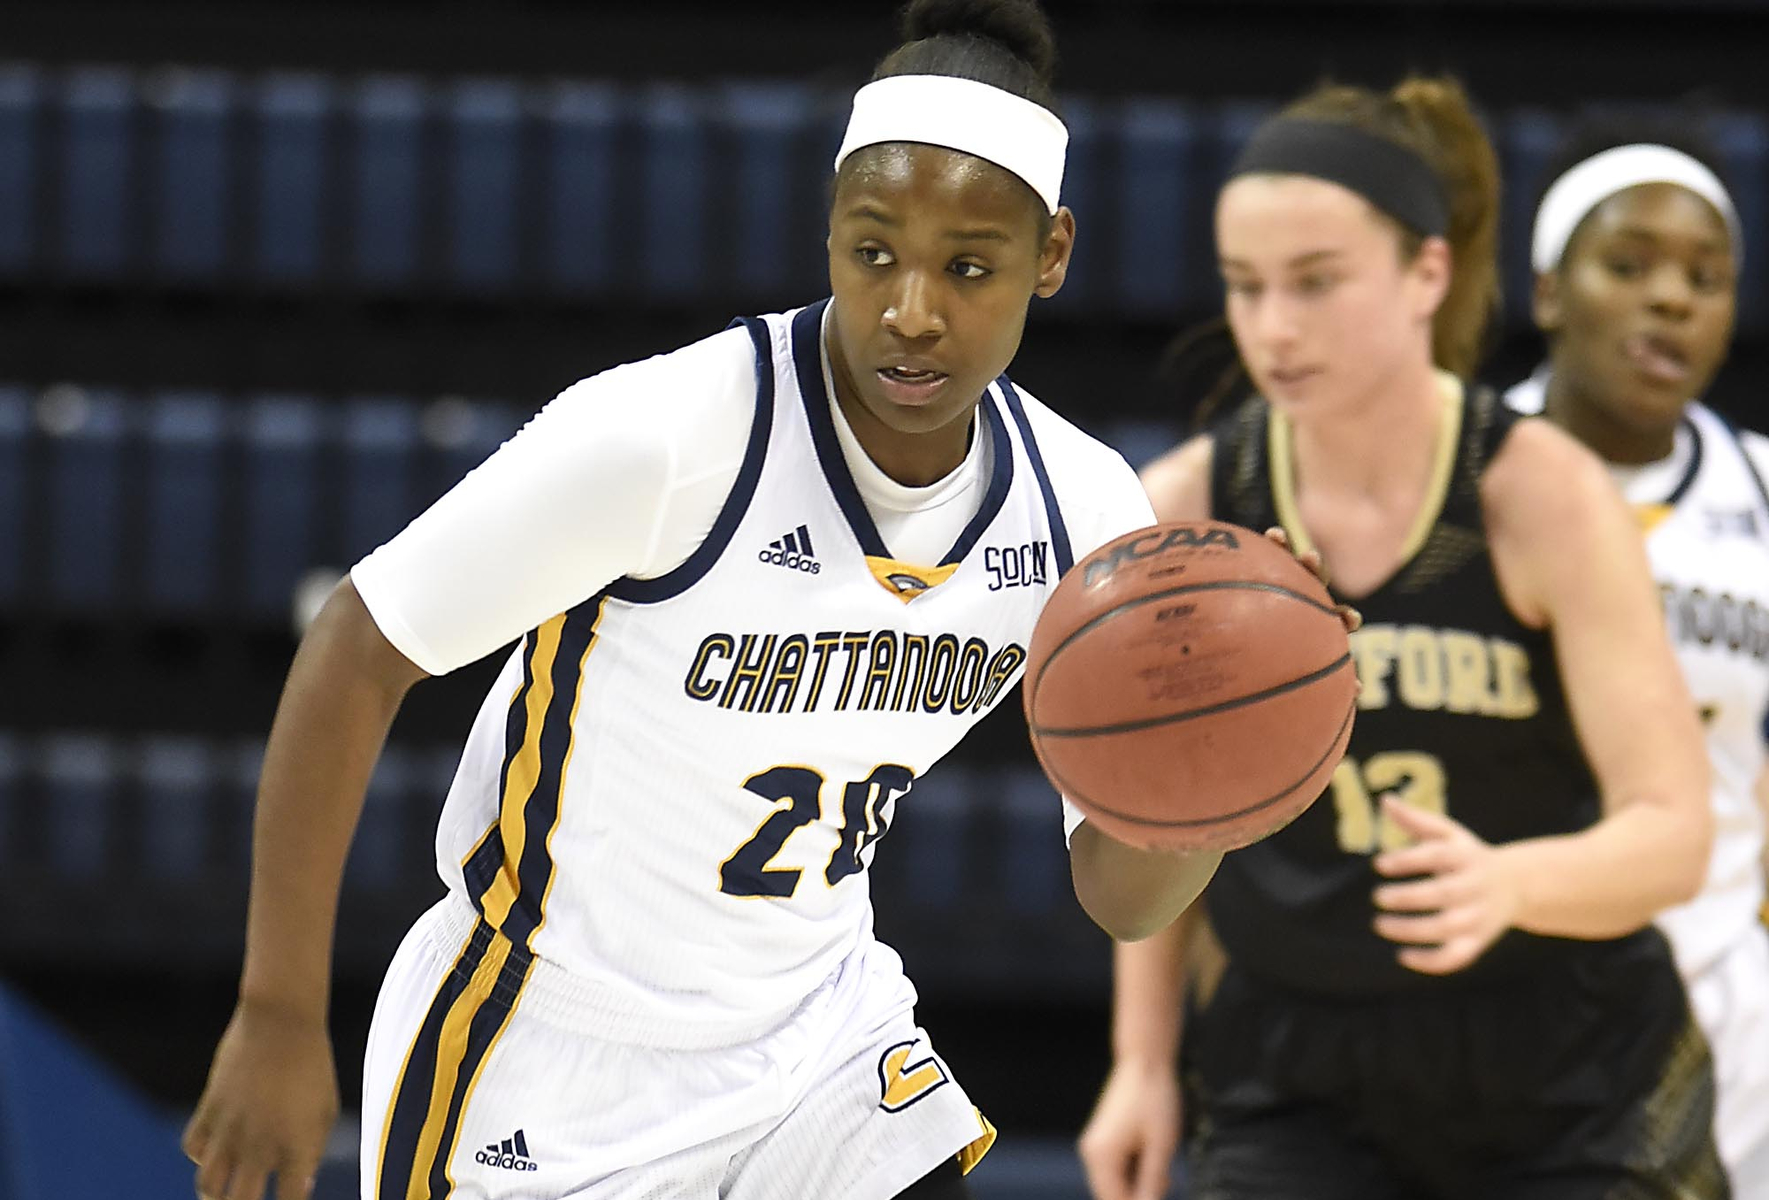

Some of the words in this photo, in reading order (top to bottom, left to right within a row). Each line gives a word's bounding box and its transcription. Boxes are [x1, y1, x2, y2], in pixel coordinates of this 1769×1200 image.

[758, 549, 821, 575] adidas
[1084, 528, 1239, 587] NCAA
[717, 763, 915, 900] 20
[475, 1151, 538, 1171] adidas
